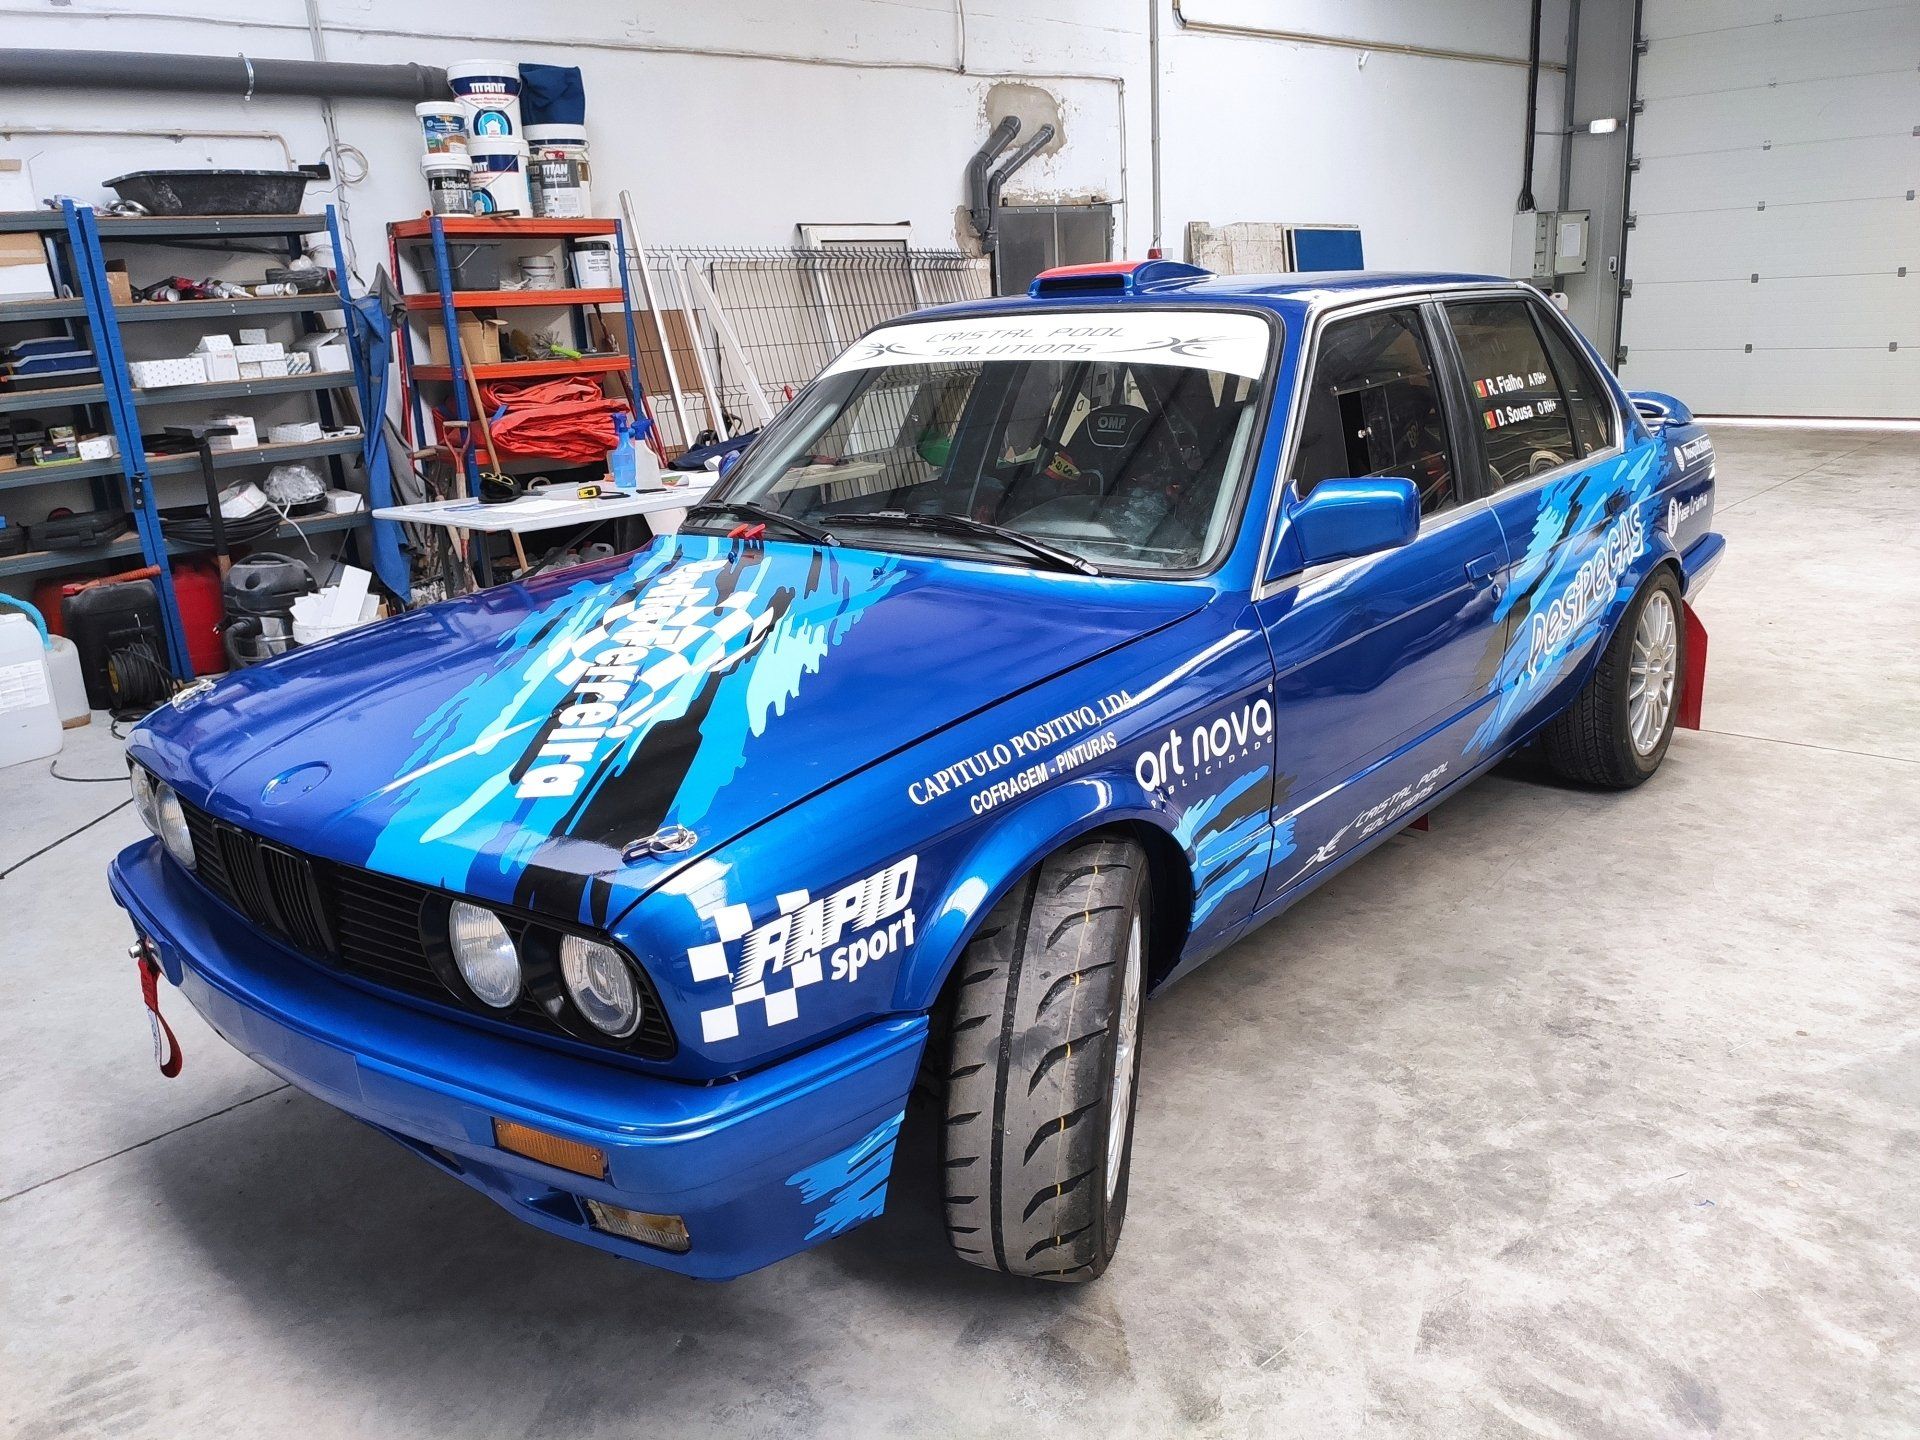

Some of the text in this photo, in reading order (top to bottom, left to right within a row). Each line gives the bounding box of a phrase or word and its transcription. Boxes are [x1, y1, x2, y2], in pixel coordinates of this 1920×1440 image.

[926, 327, 1126, 343] CRISTAL POOL
[932, 343, 1098, 357] SOLUTIONS
[1485, 378, 1499, 396] R.
[1496, 374, 1524, 394] Fialho
[1097, 416, 1127, 430] OMP
[1495, 408, 1508, 427] D.
[1506, 405, 1534, 424] Sousa
[908, 744, 1012, 806] CAPITULO
[970, 762, 1049, 815] COFRAGEM
[1056, 731, 1118, 774] PINTURAS
[1135, 699, 1272, 792] art nova
[1355, 761, 1449, 828] CRISTAL POOL
[1358, 782, 1437, 839] SOLUTIONS
[732, 854, 918, 990] RAPID
[830, 908, 916, 983] sport
